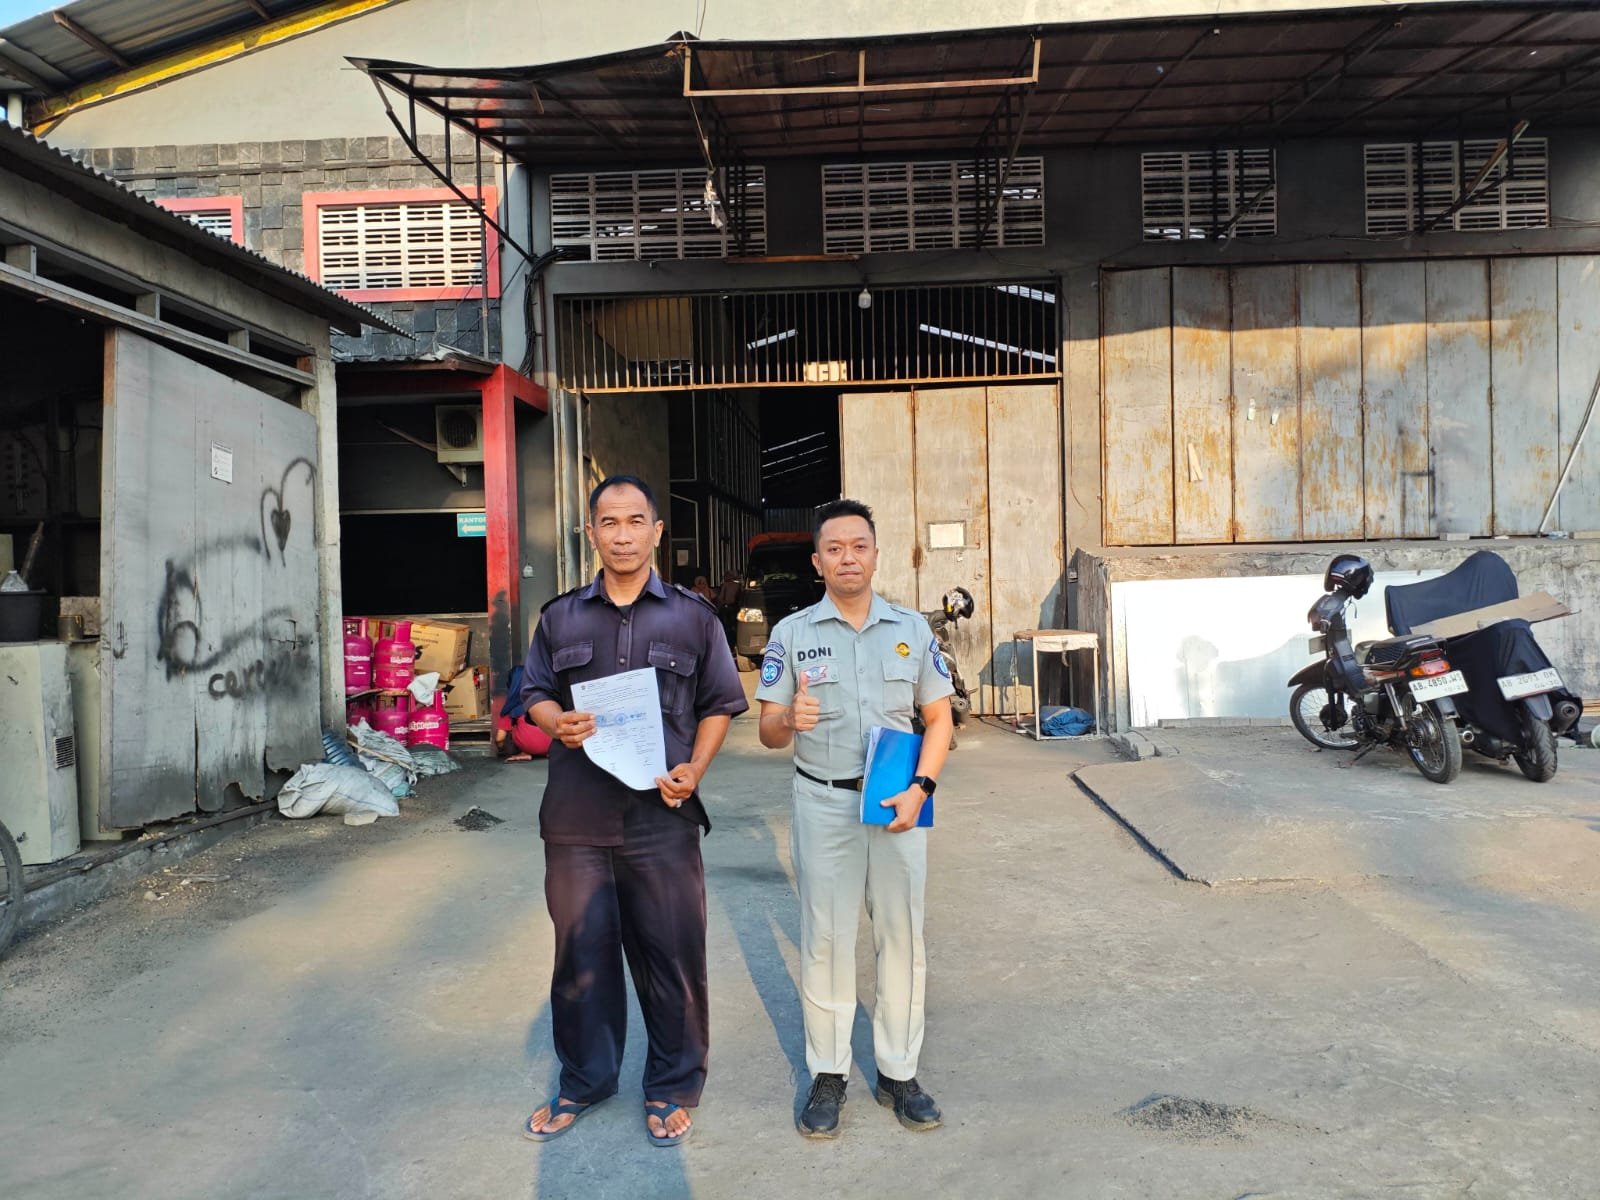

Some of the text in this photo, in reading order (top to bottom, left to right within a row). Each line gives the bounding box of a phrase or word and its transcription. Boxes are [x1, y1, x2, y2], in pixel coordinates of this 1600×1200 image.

[797, 647, 832, 662] DONI
[1412, 682, 1424, 691] AB
[1501, 680, 1513, 688] AB
